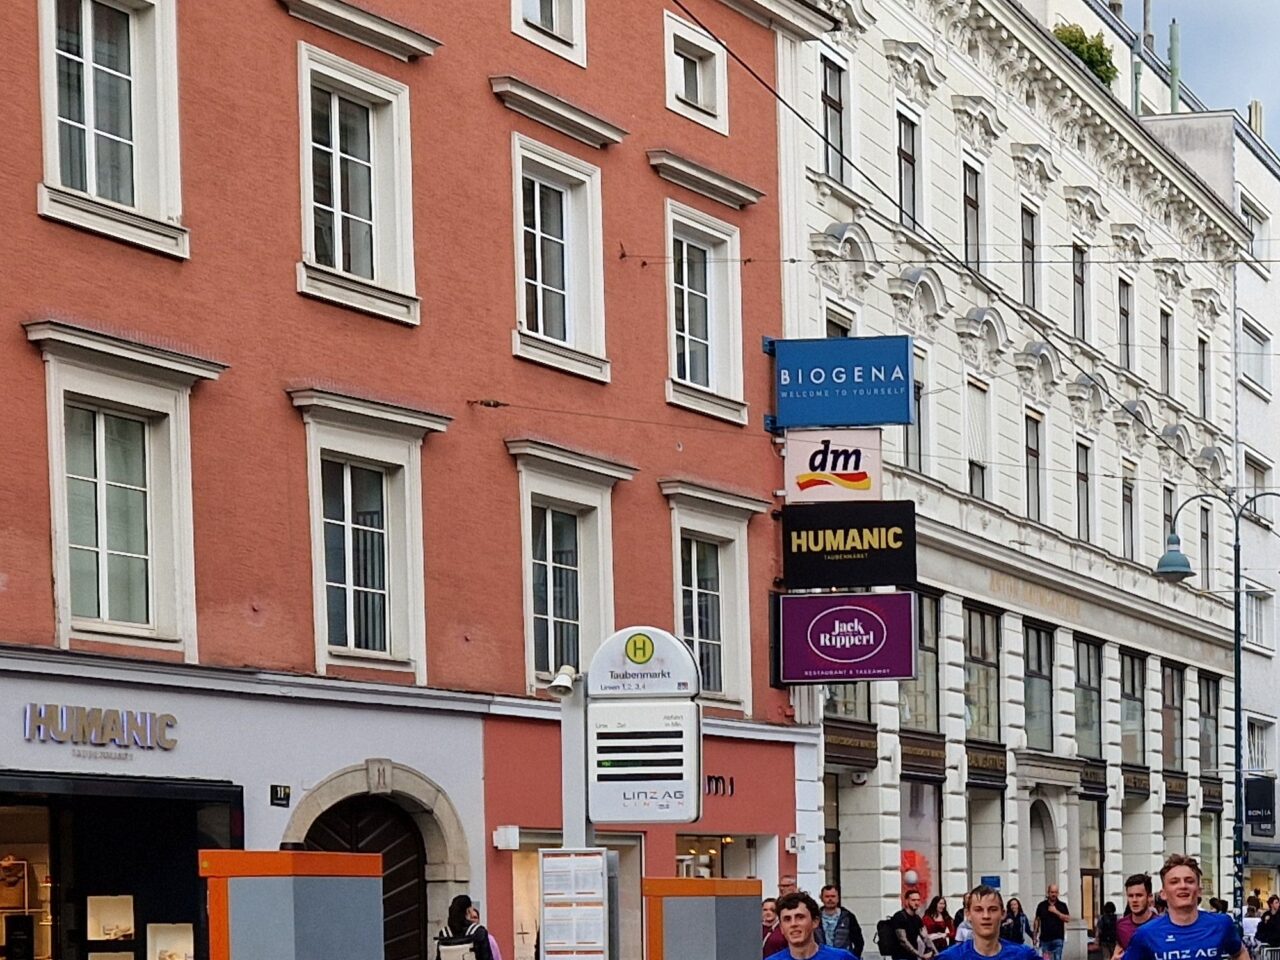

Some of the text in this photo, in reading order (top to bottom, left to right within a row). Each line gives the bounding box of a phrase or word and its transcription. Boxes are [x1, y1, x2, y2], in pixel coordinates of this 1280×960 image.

[780, 364, 905, 385] BIOGENA
[781, 390, 829, 398] WELCOME
[853, 386, 905, 396] YOURSELF
[808, 440, 862, 472] dm
[791, 527, 903, 552] HUMANIC
[823, 552, 868, 561] TAUBENMARKT
[832, 618, 865, 636] Jack
[820, 631, 874, 648] Ripperl
[609, 671, 671, 680] Taubenmarkt
[24, 703, 178, 751] HUMANIC
[623, 790, 684, 800] LINZ AG
[1154, 948, 1218, 960] LINZ AG
